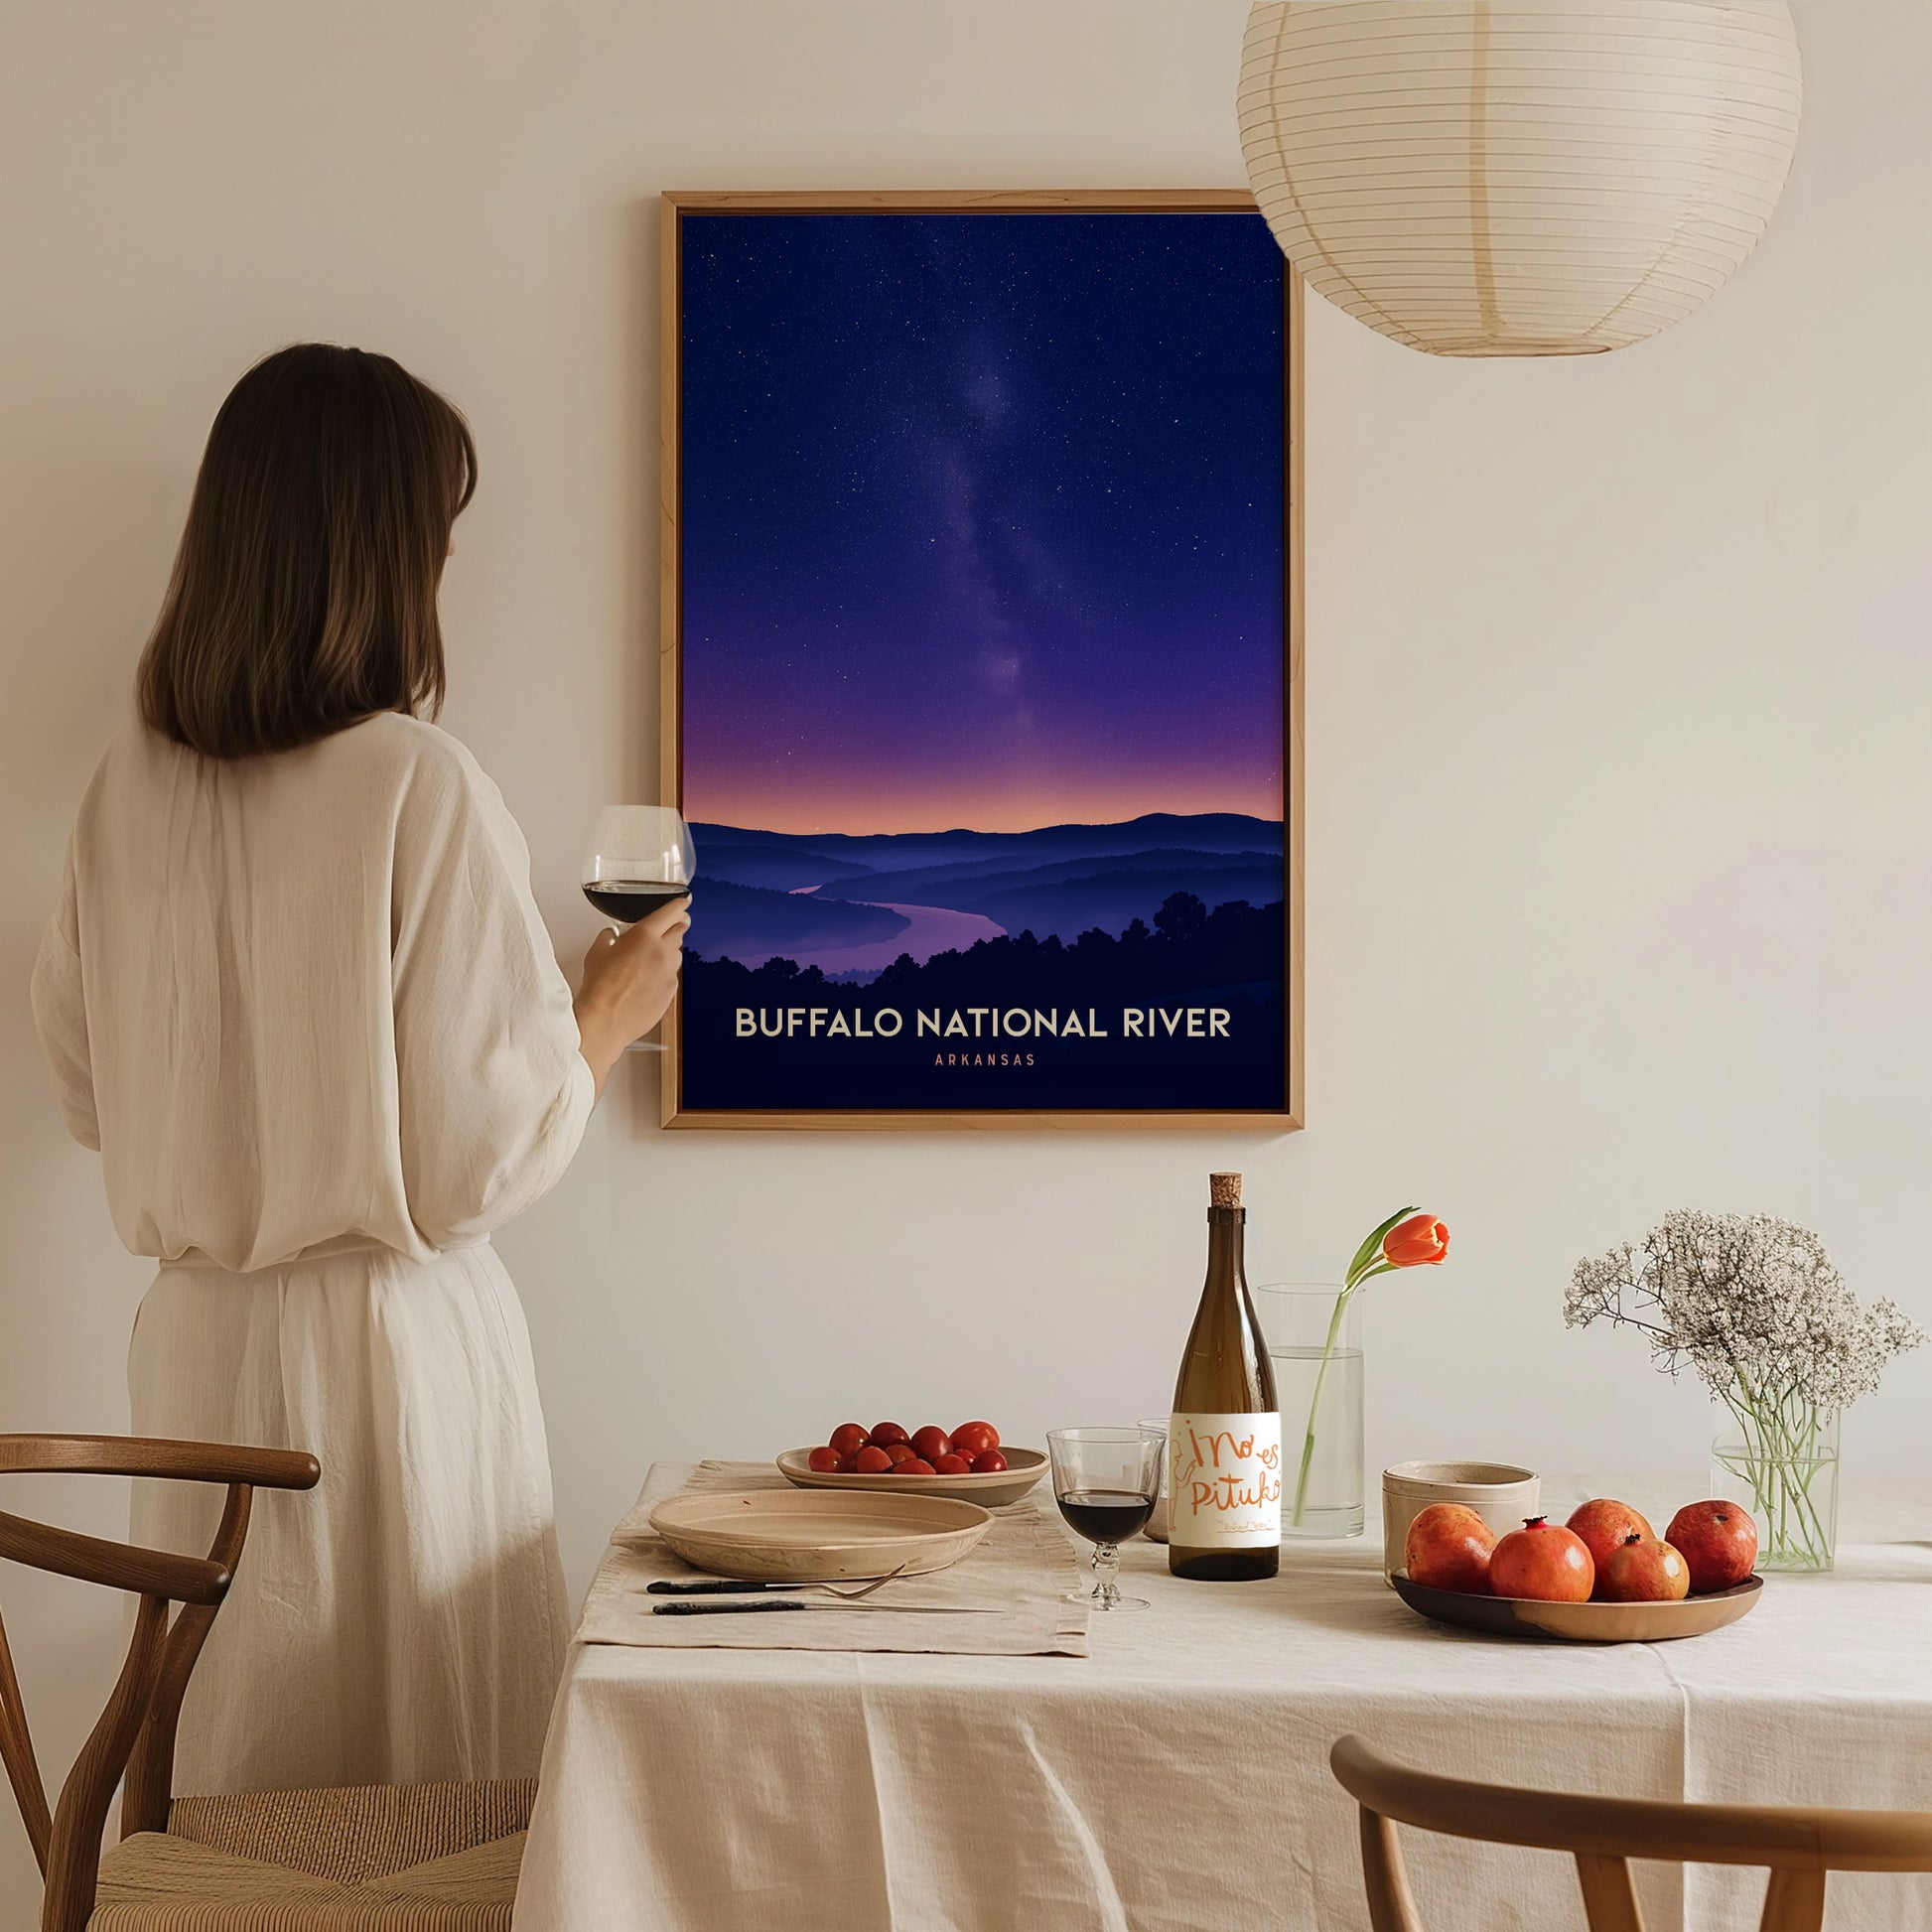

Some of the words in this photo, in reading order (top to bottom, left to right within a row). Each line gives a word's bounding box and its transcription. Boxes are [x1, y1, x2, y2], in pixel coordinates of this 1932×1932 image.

[736, 1008, 901, 1036] BUFFALO
[917, 1008, 1107, 1036] NATIONAL
[1123, 1008, 1231, 1036] RIVER
[935, 1053, 1035, 1065] ARKANSAS
[1256, 1444, 1279, 1469] es
